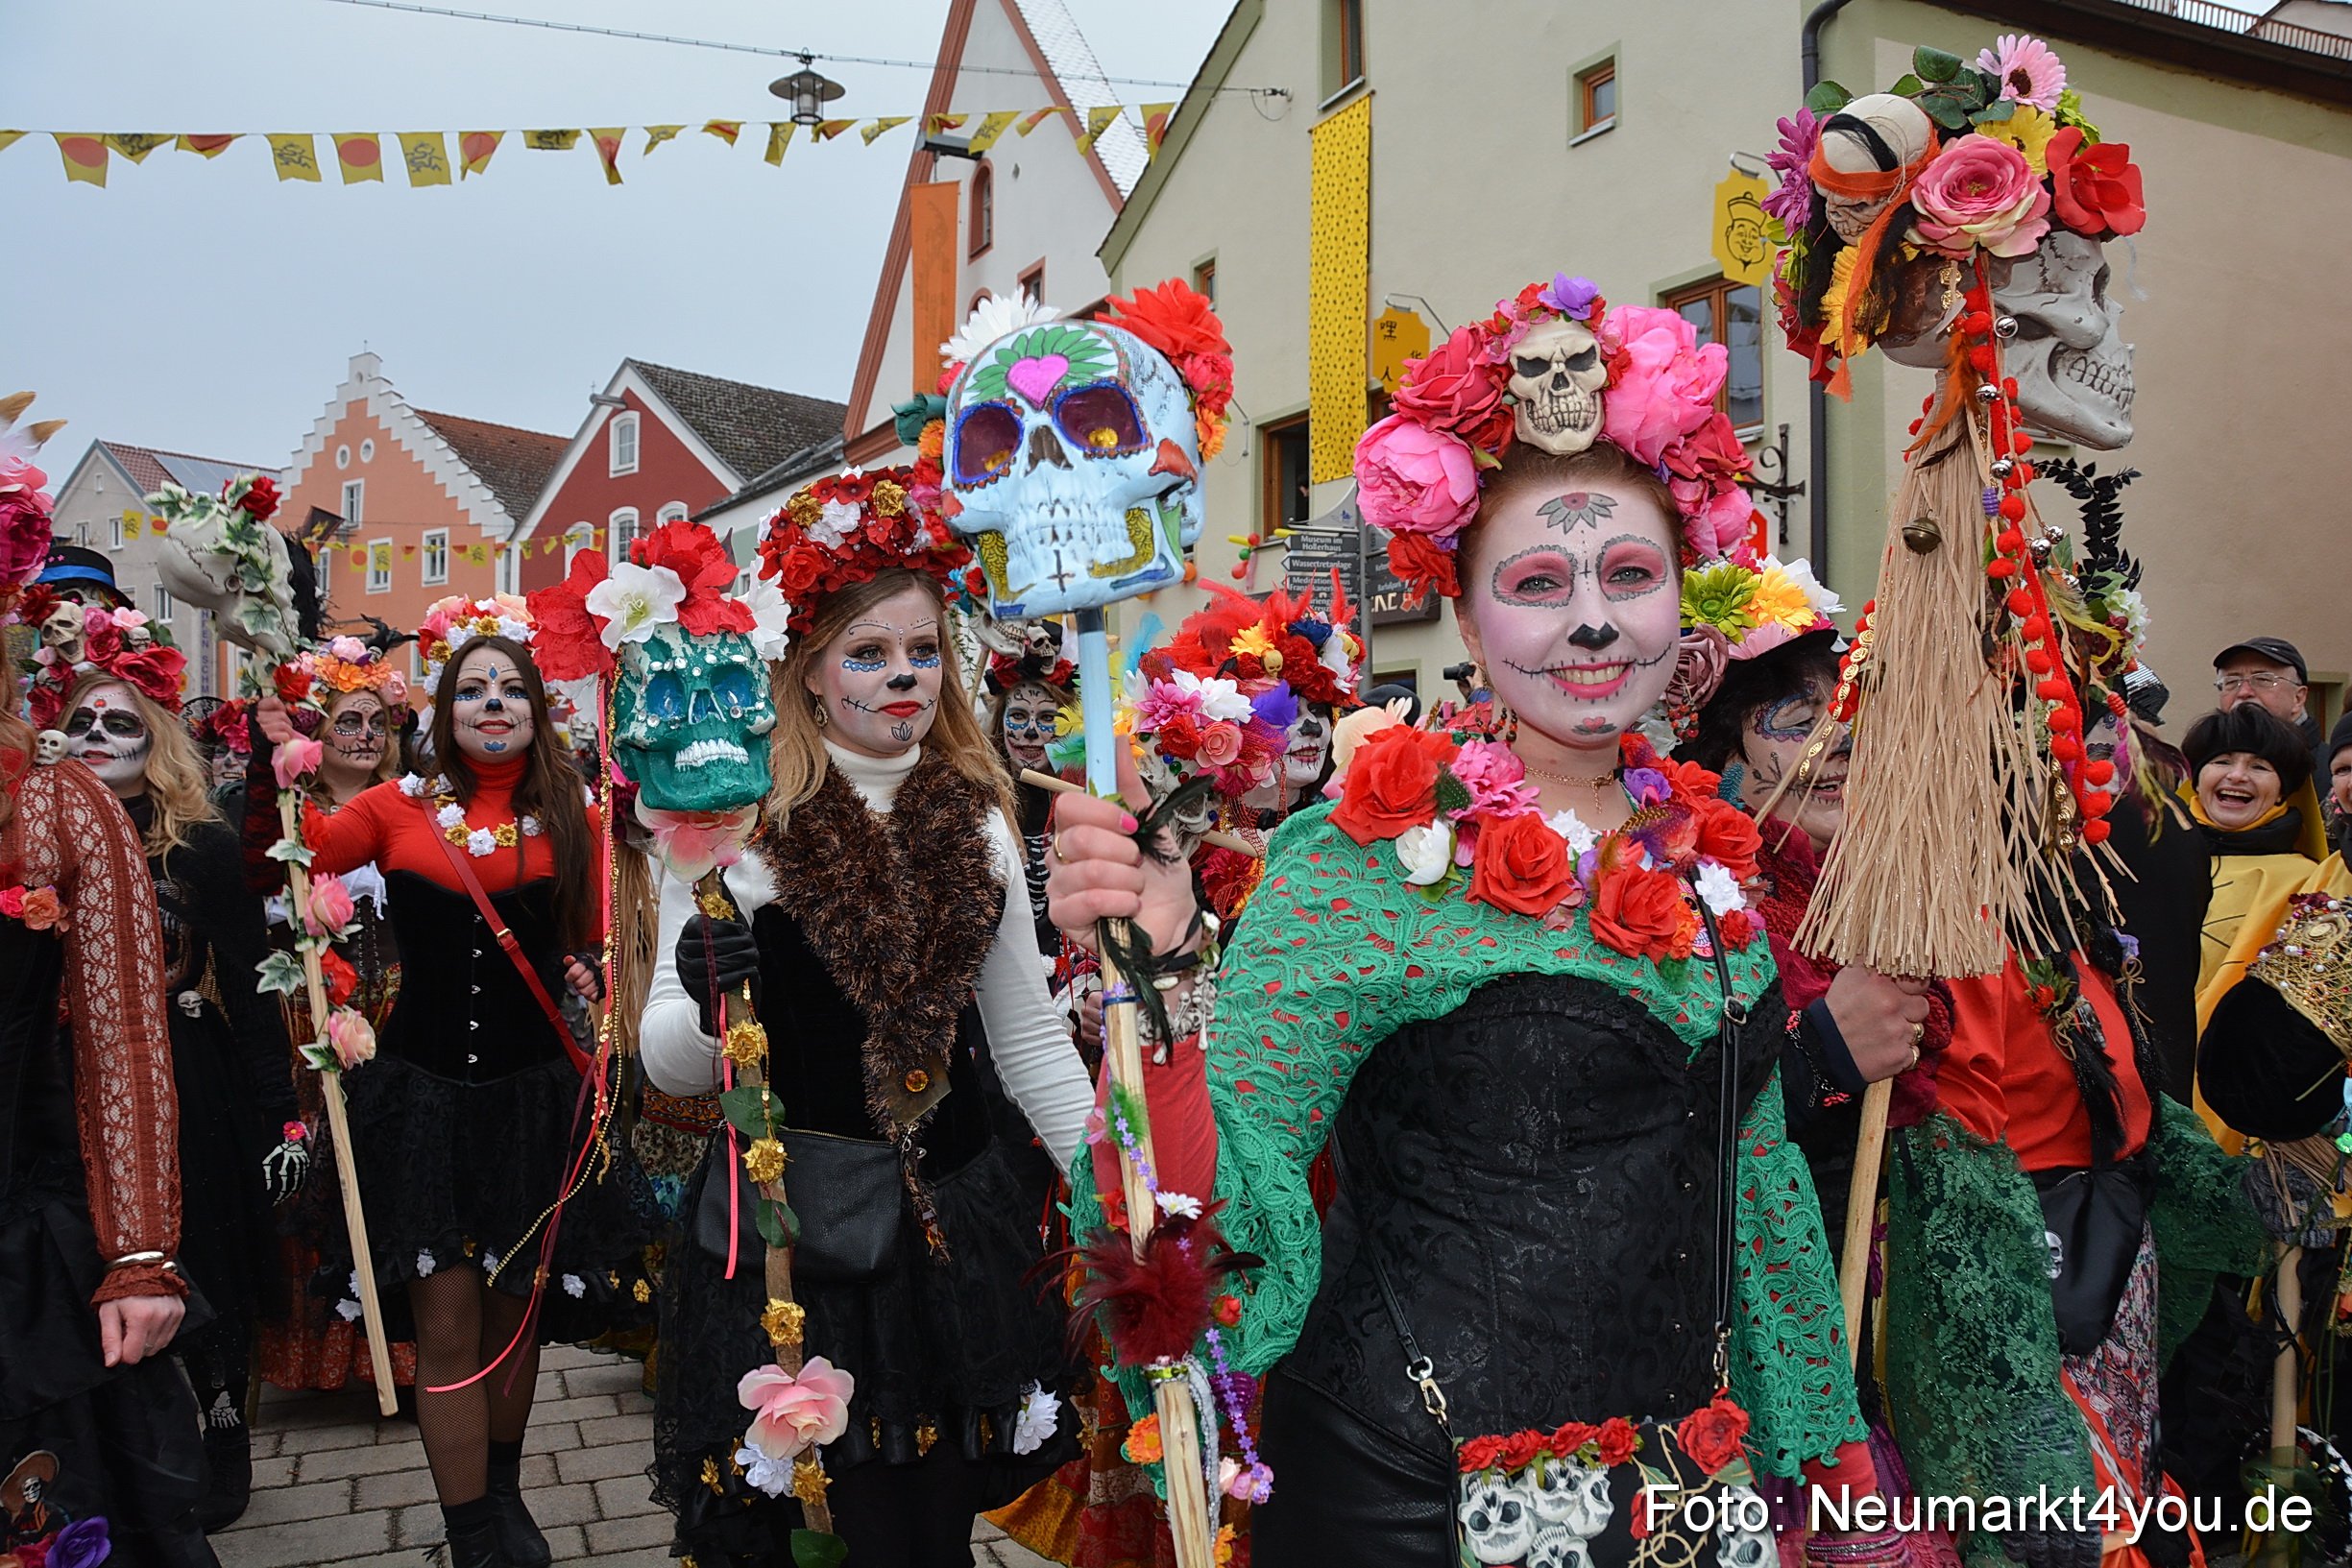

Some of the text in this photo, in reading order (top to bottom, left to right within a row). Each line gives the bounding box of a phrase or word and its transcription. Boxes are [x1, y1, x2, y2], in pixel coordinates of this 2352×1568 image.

[1300, 535, 1332, 544] Museum
[1302, 543, 1342, 551] Hollerhaus
[1292, 559, 1352, 570] Wassertretanlage
